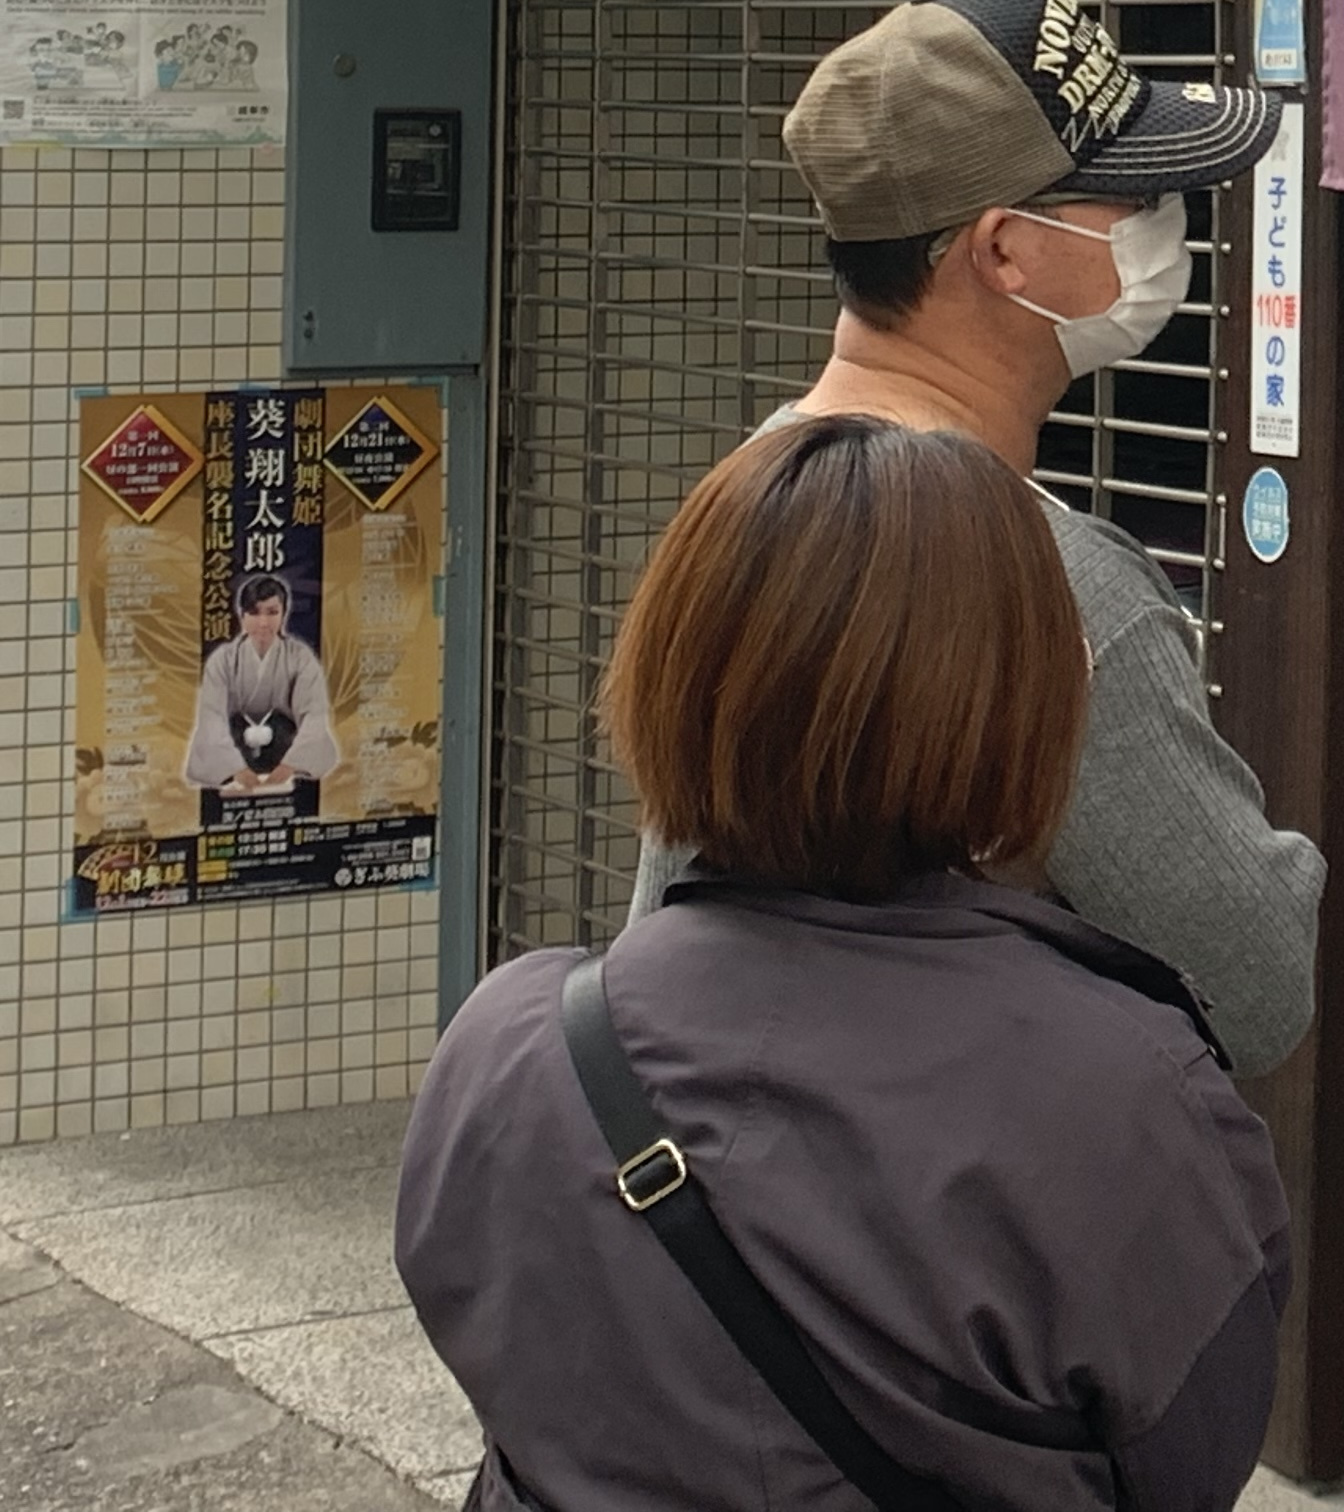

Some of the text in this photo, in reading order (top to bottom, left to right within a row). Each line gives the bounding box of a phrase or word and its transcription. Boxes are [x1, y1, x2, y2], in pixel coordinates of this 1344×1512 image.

[203, 400, 235, 642] 座長襲名記念公演
[293, 398, 324, 526] 劇団舞姫
